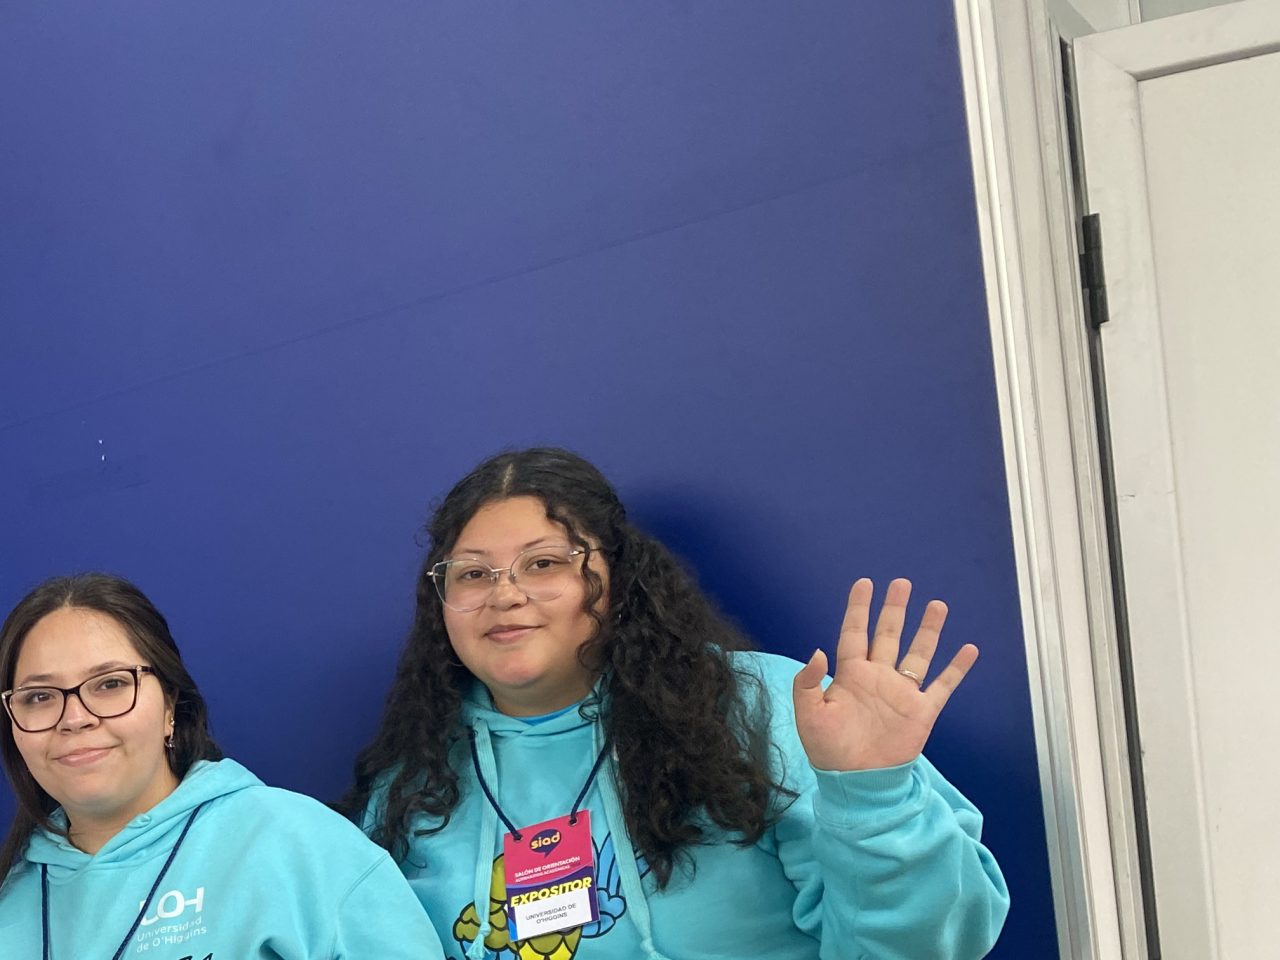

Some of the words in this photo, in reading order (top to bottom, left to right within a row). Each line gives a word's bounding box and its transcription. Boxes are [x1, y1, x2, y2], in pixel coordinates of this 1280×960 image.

[531, 832, 561, 849] siad
[510, 877, 592, 907] EXPOSITOR
[526, 904, 567, 921] UNIVERSIDAD
[137, 916, 202, 942] Universidad
[136, 943, 149, 953] de
